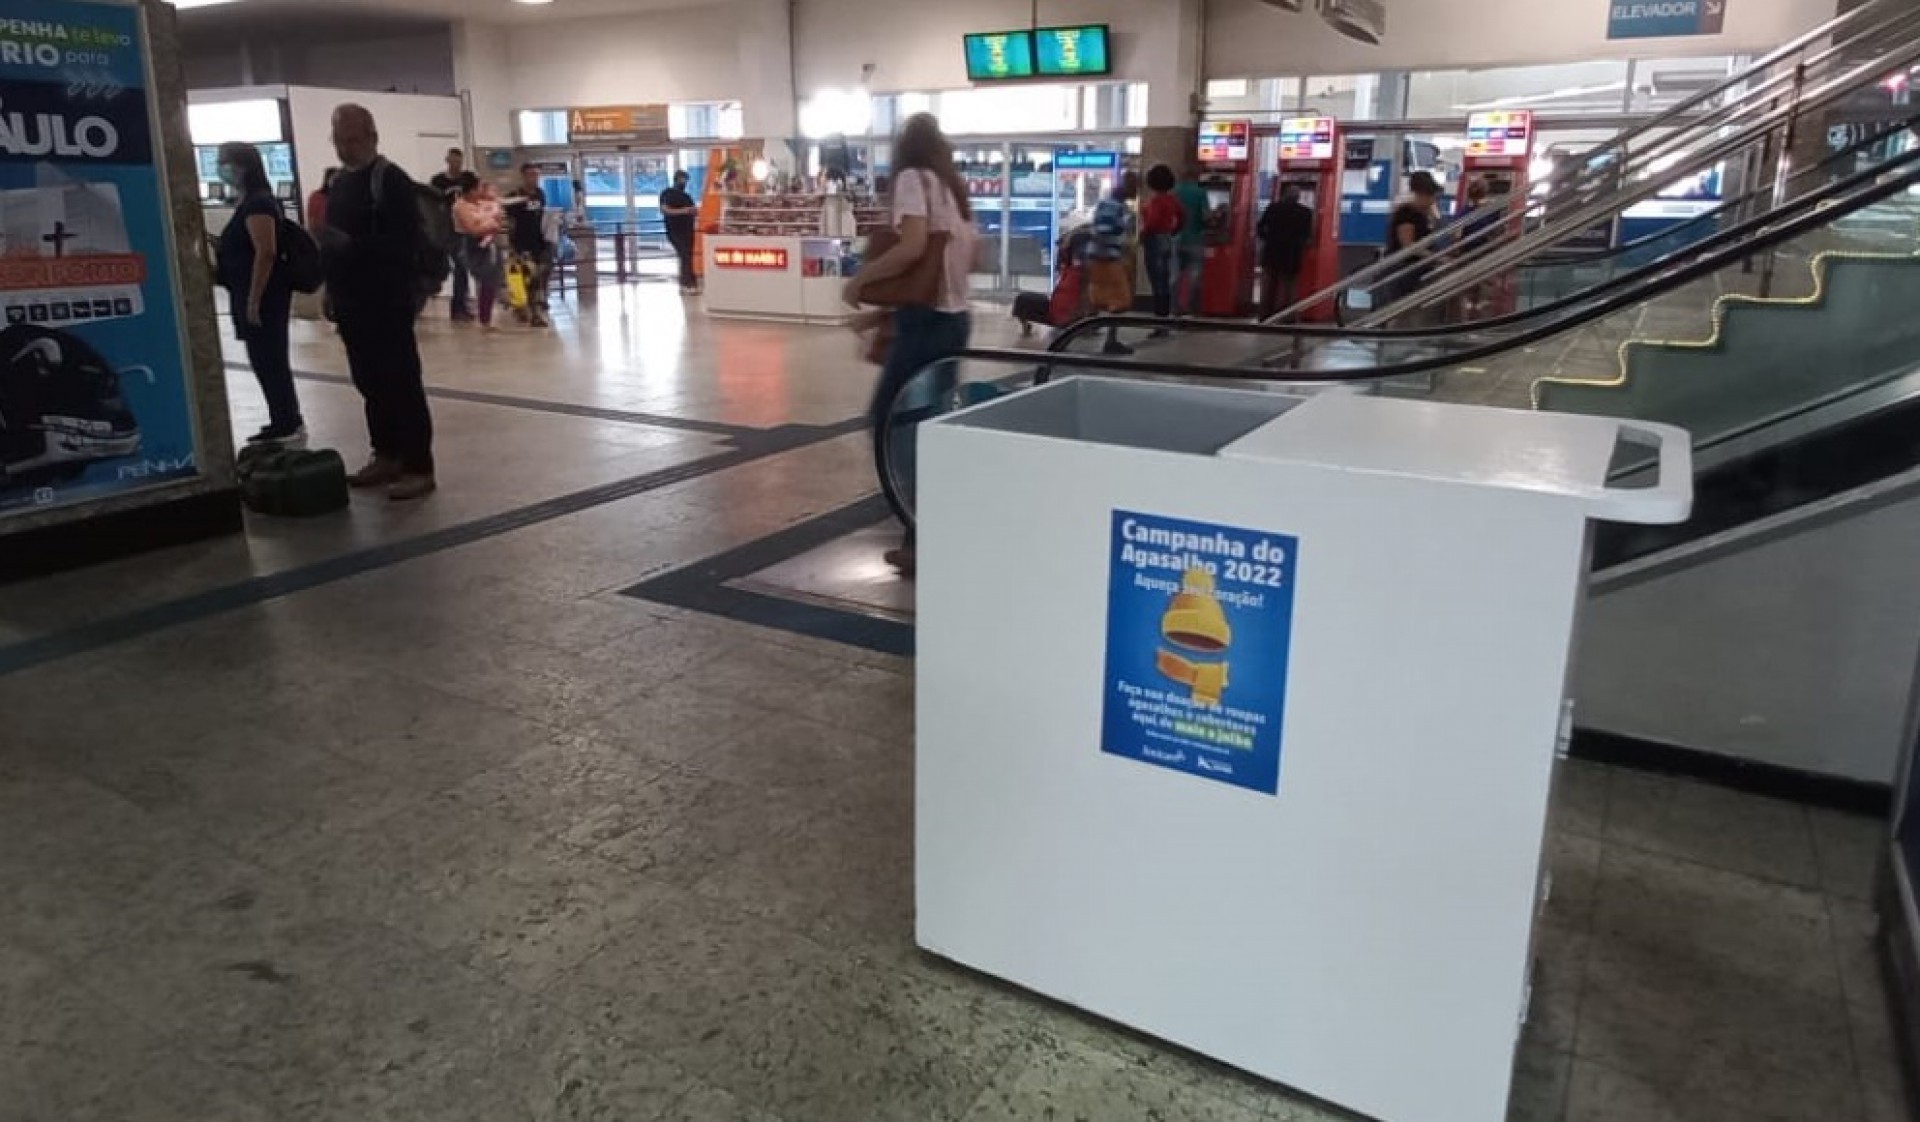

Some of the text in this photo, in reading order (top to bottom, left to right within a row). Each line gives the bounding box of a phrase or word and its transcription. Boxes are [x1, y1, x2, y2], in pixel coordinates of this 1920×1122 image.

[1611, 1, 1697, 19] ELEVADOR
[0, 19, 68, 40] PENHA
[2, 39, 110, 66] RIO para
[1121, 518, 1285, 564] Campanha do
[1120, 543, 1282, 587] Agasalho 2022
